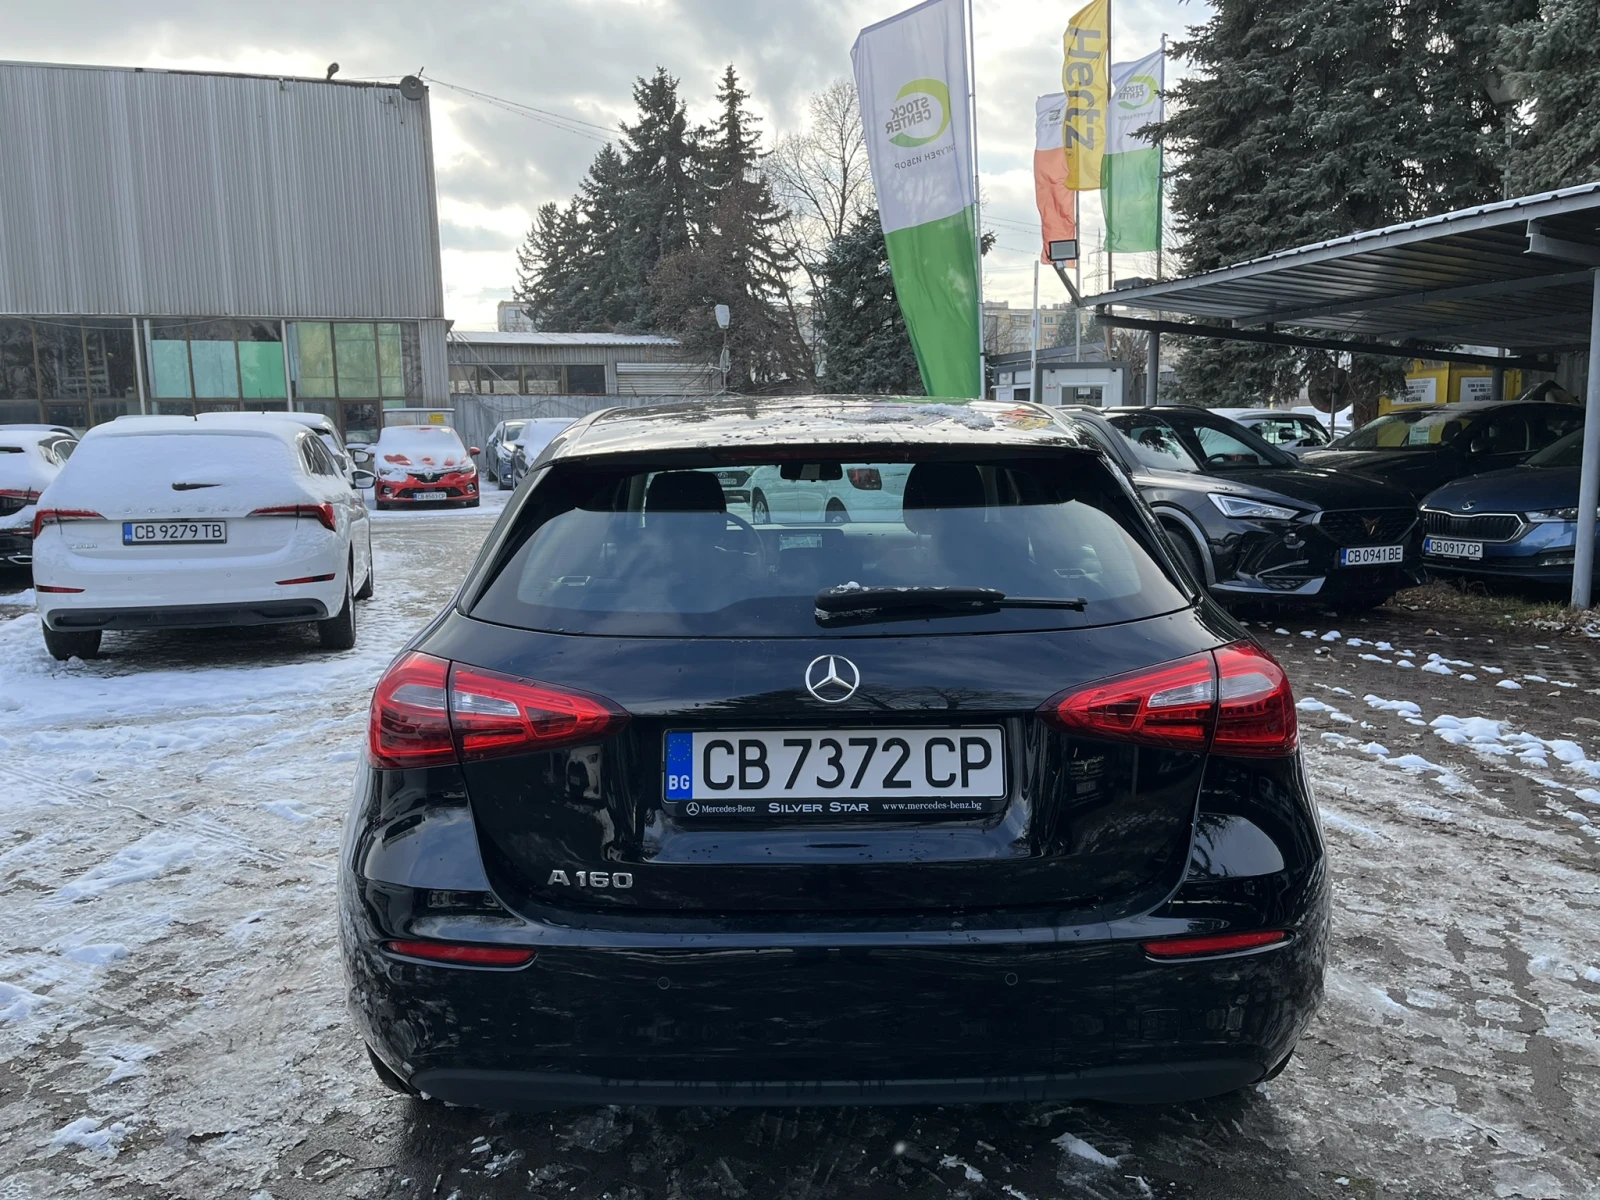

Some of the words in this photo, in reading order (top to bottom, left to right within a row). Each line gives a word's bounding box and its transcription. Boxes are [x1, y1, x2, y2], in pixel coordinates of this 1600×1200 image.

[1066, 28, 1101, 151] Hertz
[135, 525, 156, 540] CB
[159, 524, 198, 539] 9279
[202, 524, 222, 538] TB
[1347, 550, 1361, 563] CB
[1363, 548, 1386, 562] 0941
[1388, 547, 1402, 560] BE
[1431, 541, 1443, 552] CB
[1443, 542, 1466, 555] 0917
[1467, 544, 1481, 555] CP
[668, 774, 690, 790] BG
[702, 738, 770, 791] CB
[783, 737, 912, 790] 7372
[924, 736, 993, 788] CP
[701, 804, 756, 813] Mercedes-Benz
[768, 802, 823, 813] SILVER
[829, 802, 870, 812] STAR
[882, 801, 982, 811] www.mercedes-benz.bg
[547, 869, 571, 886] A
[575, 870, 633, 889] 160
